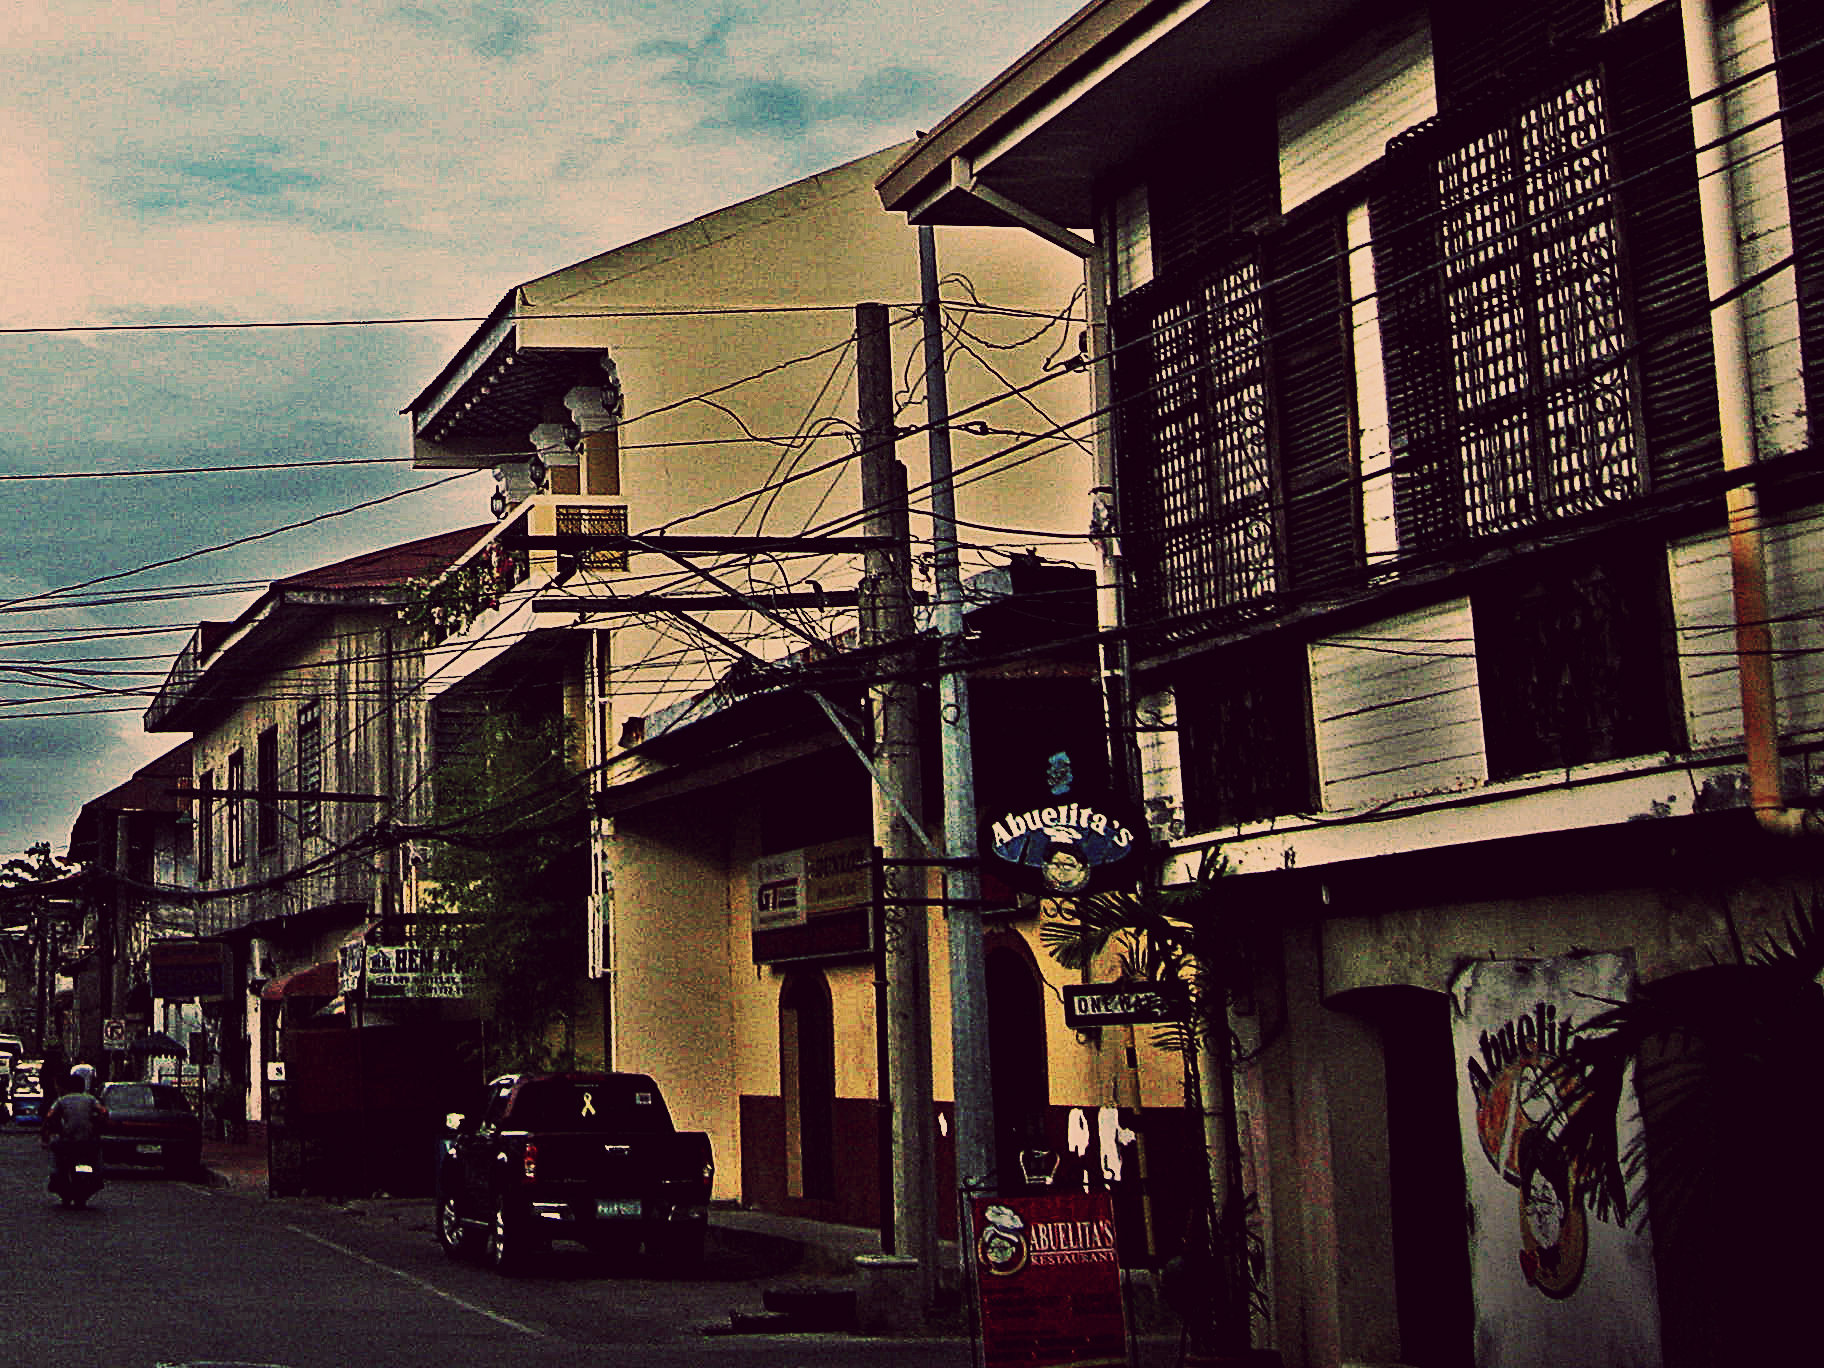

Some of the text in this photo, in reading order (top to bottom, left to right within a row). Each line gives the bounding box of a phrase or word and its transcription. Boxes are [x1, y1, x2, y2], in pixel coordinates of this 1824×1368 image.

[992, 803, 1134, 847] Abuelita's
[1030, 1220, 1114, 1251] ABUELITA'S
[1031, 1252, 1115, 1266] RESTAURANT
